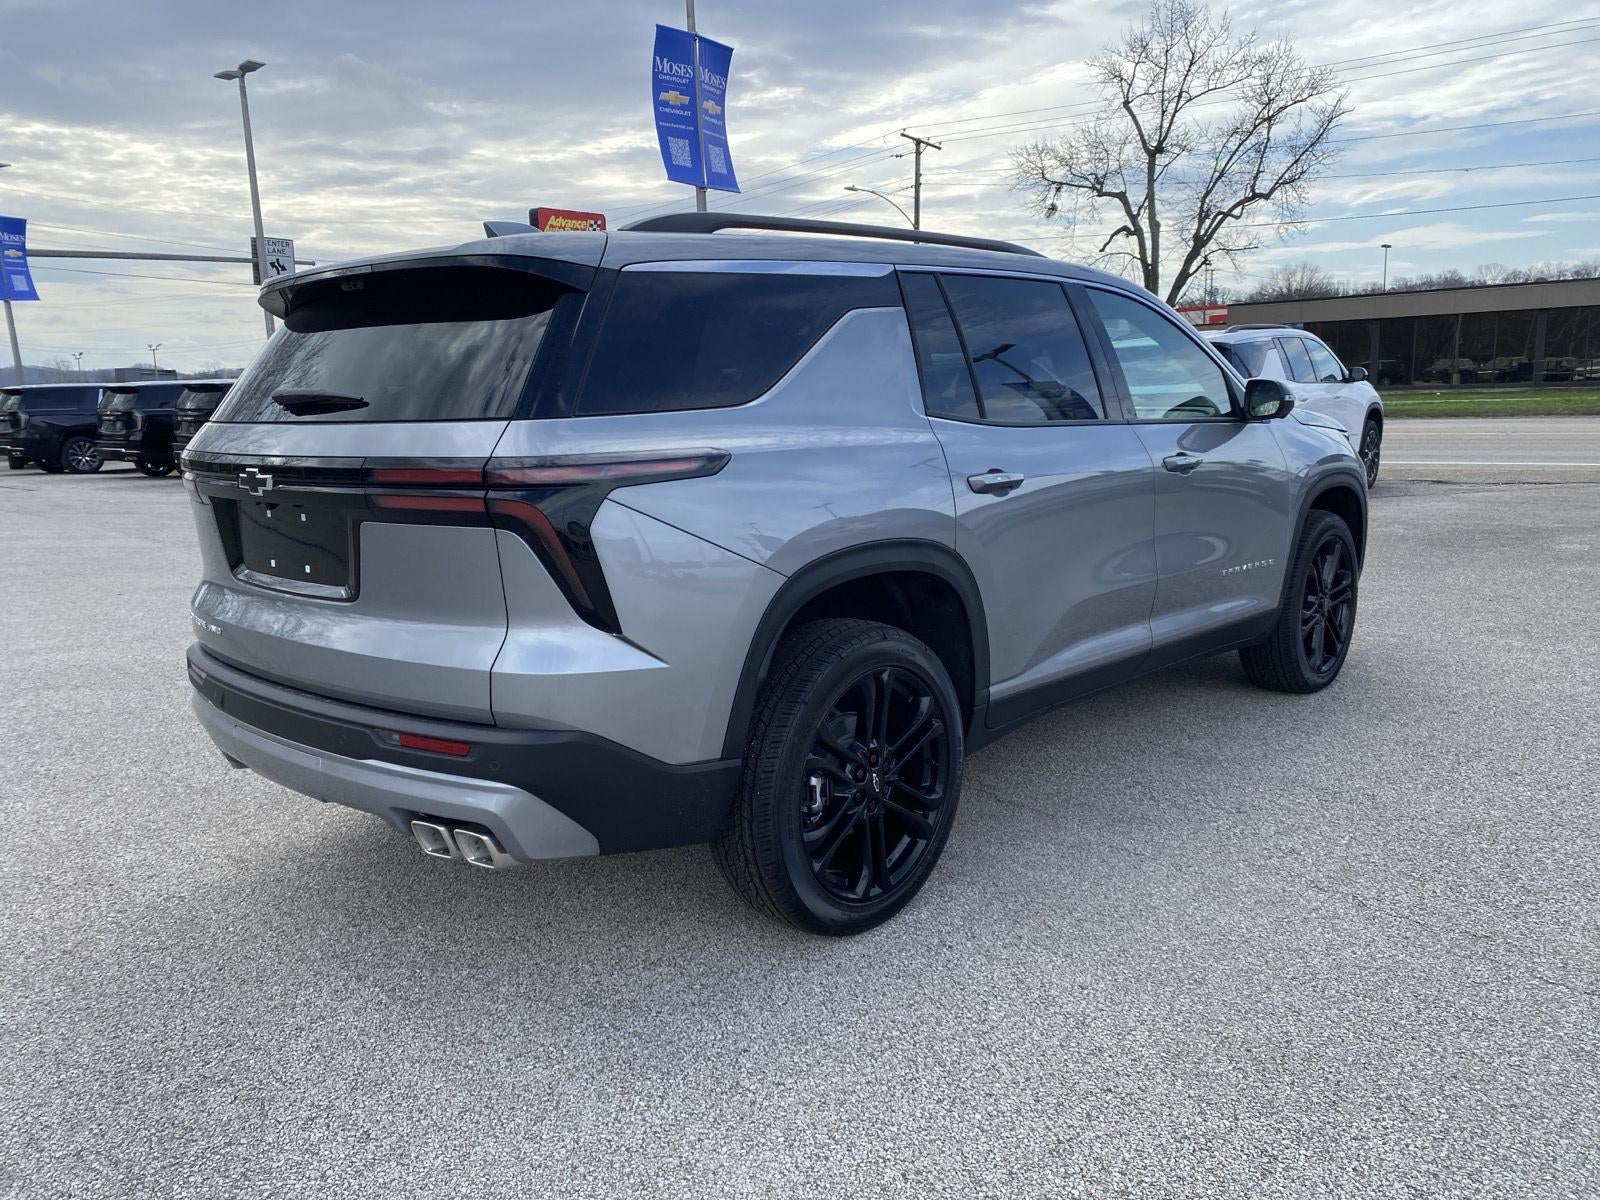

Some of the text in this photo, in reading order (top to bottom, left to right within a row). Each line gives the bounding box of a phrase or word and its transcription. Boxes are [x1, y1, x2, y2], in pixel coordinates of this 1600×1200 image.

[654, 56, 694, 78] MOSES
[658, 74, 690, 84] CHEVROLET
[699, 66, 727, 90] MOSES
[659, 106, 691, 117] CHEVROLET
[548, 215, 587, 229] Advance
[264, 239, 290, 248] ENTER
[267, 247, 287, 255] LANE
